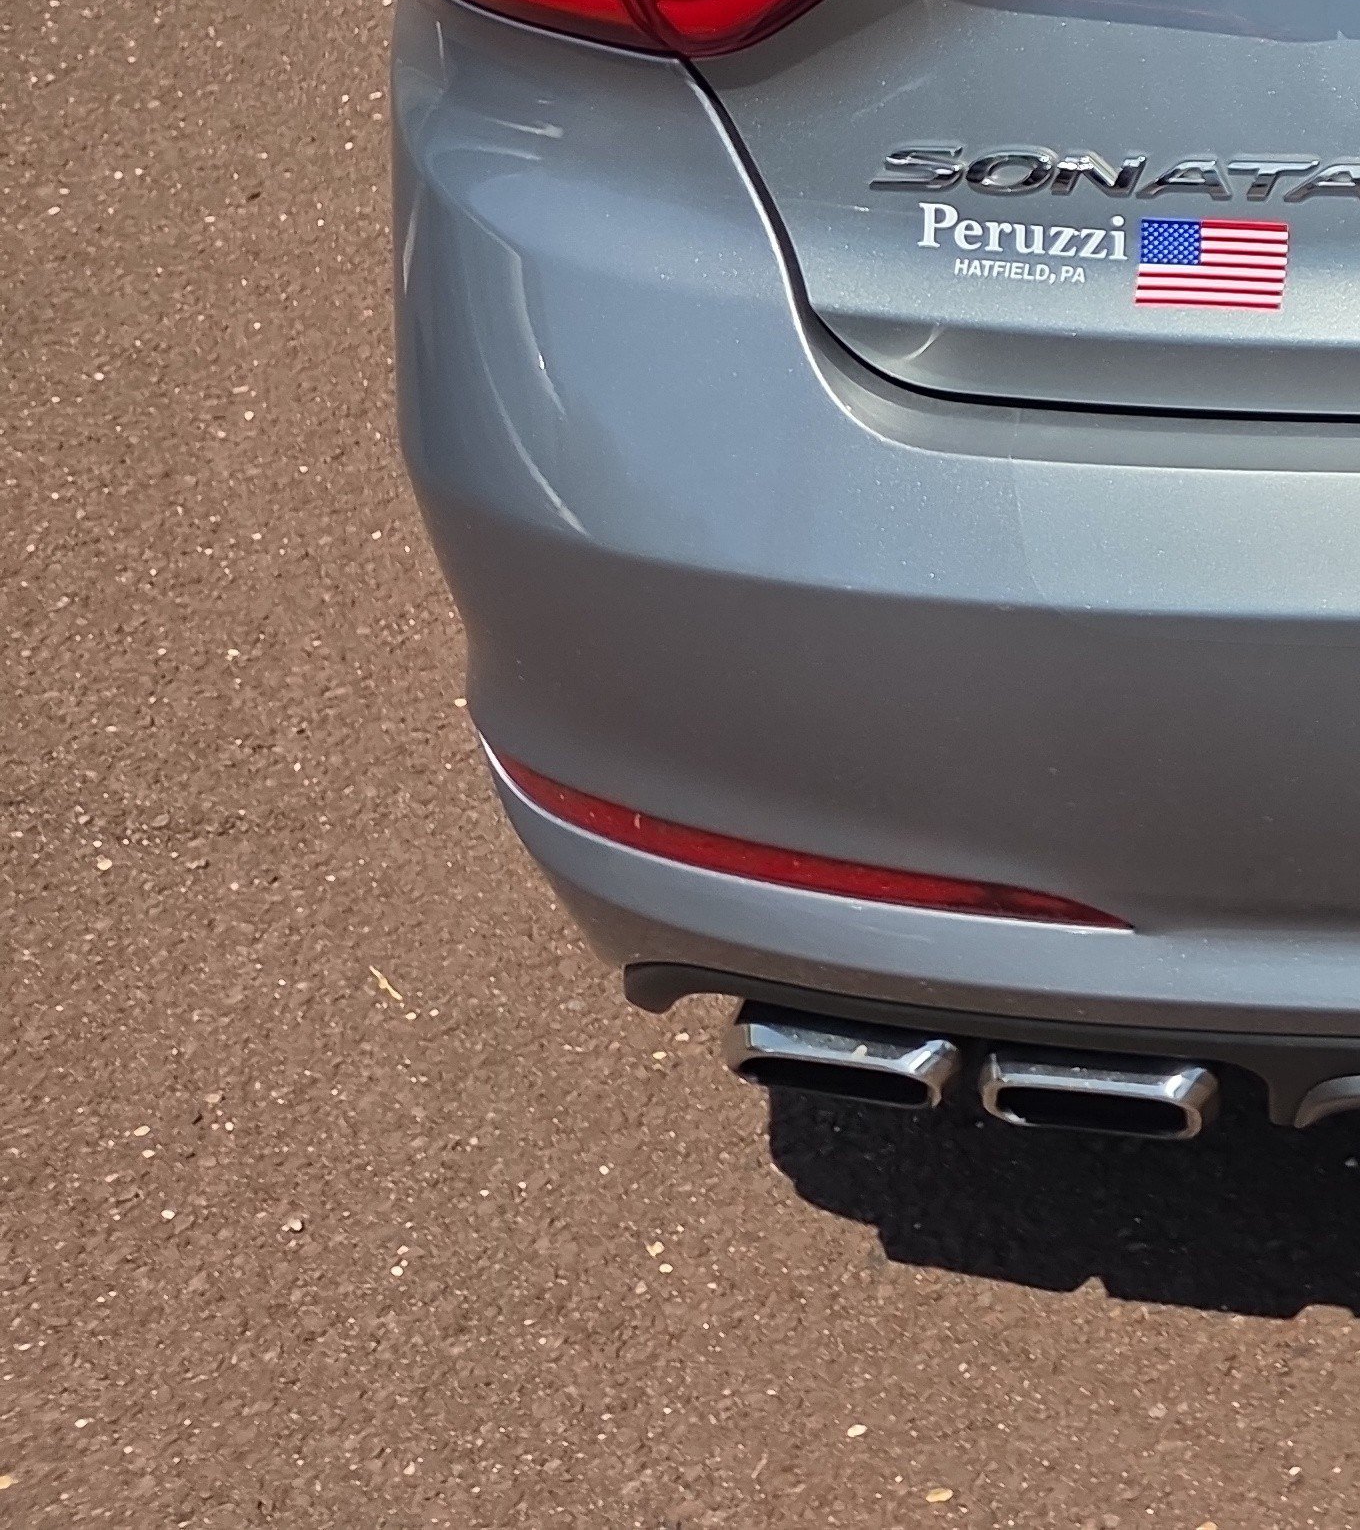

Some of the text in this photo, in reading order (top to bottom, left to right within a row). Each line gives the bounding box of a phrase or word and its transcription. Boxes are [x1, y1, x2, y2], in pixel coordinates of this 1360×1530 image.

[917, 202, 1128, 260] Peruzzi
[954, 258, 1086, 285] HATFIELD, PA
